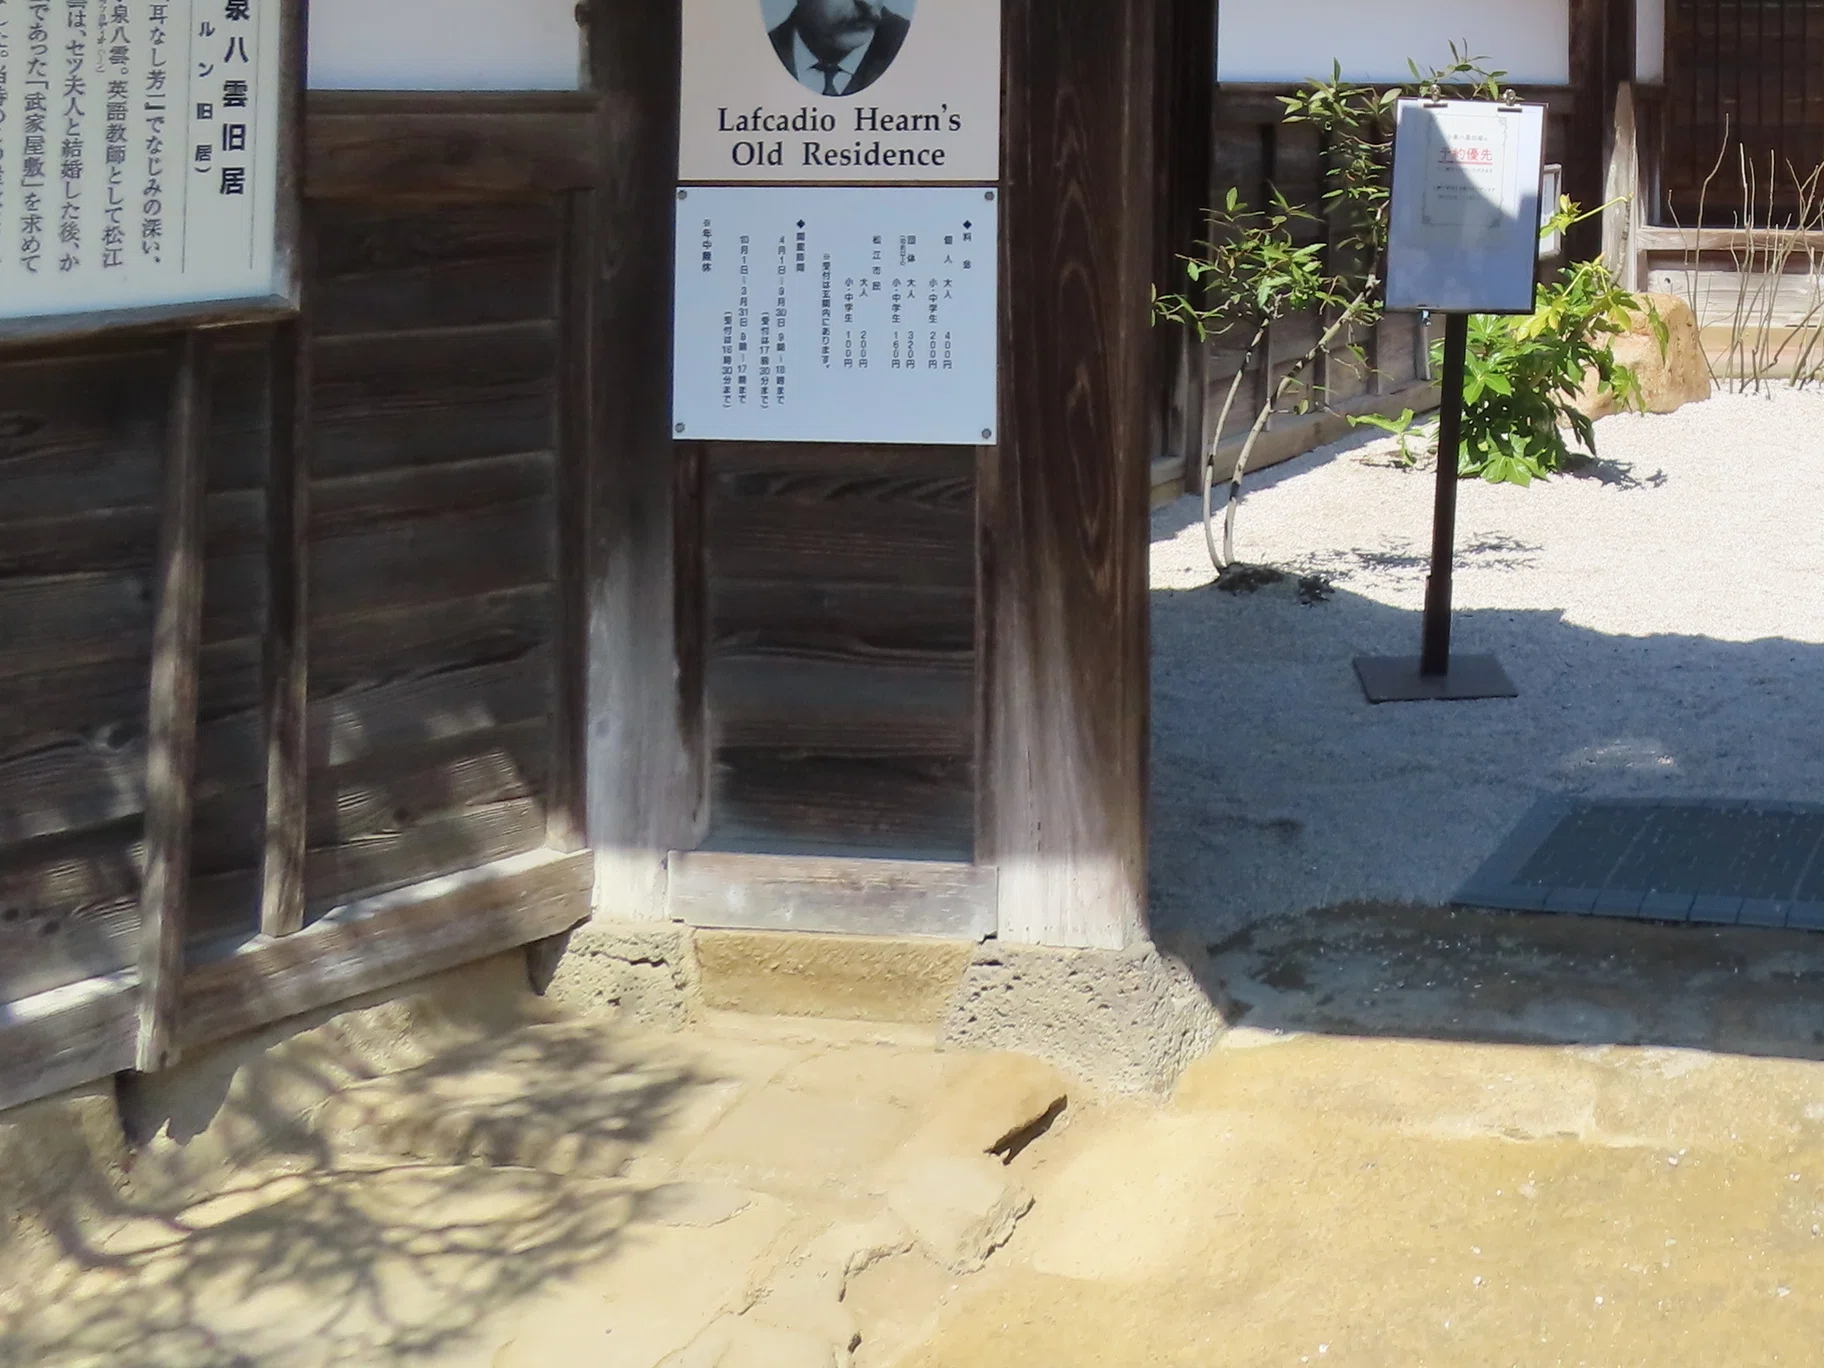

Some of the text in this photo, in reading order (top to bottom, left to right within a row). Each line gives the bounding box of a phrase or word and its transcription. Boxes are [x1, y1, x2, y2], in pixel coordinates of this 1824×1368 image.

[717, 104, 962, 132] Lafcadio Hearn's
[732, 141, 946, 166] Old Residence
[859, 277, 868, 297] 大人
[906, 278, 916, 299] 大人
[943, 278, 953, 299] 大人
